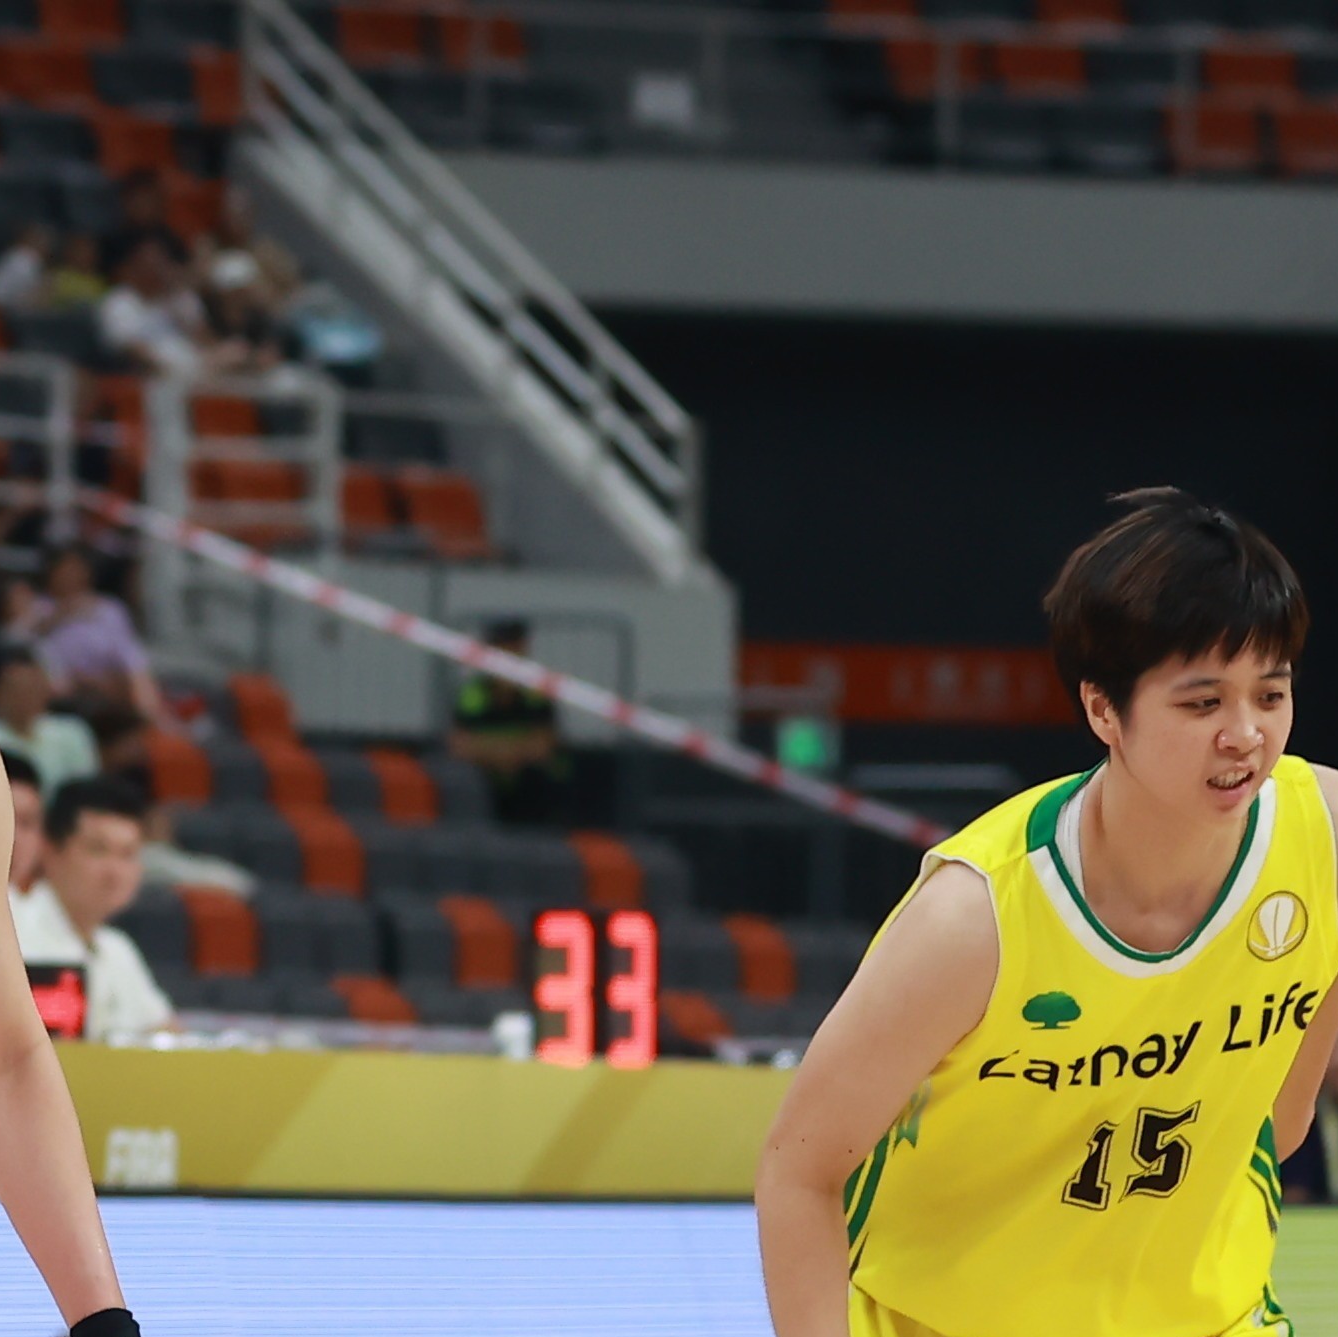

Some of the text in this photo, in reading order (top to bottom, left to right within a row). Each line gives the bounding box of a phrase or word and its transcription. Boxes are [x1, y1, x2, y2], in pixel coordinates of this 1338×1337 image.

[534, 909, 658, 1068] 33
[1221, 982, 1319, 1053] Life
[1061, 1100, 1201, 1211] 15
